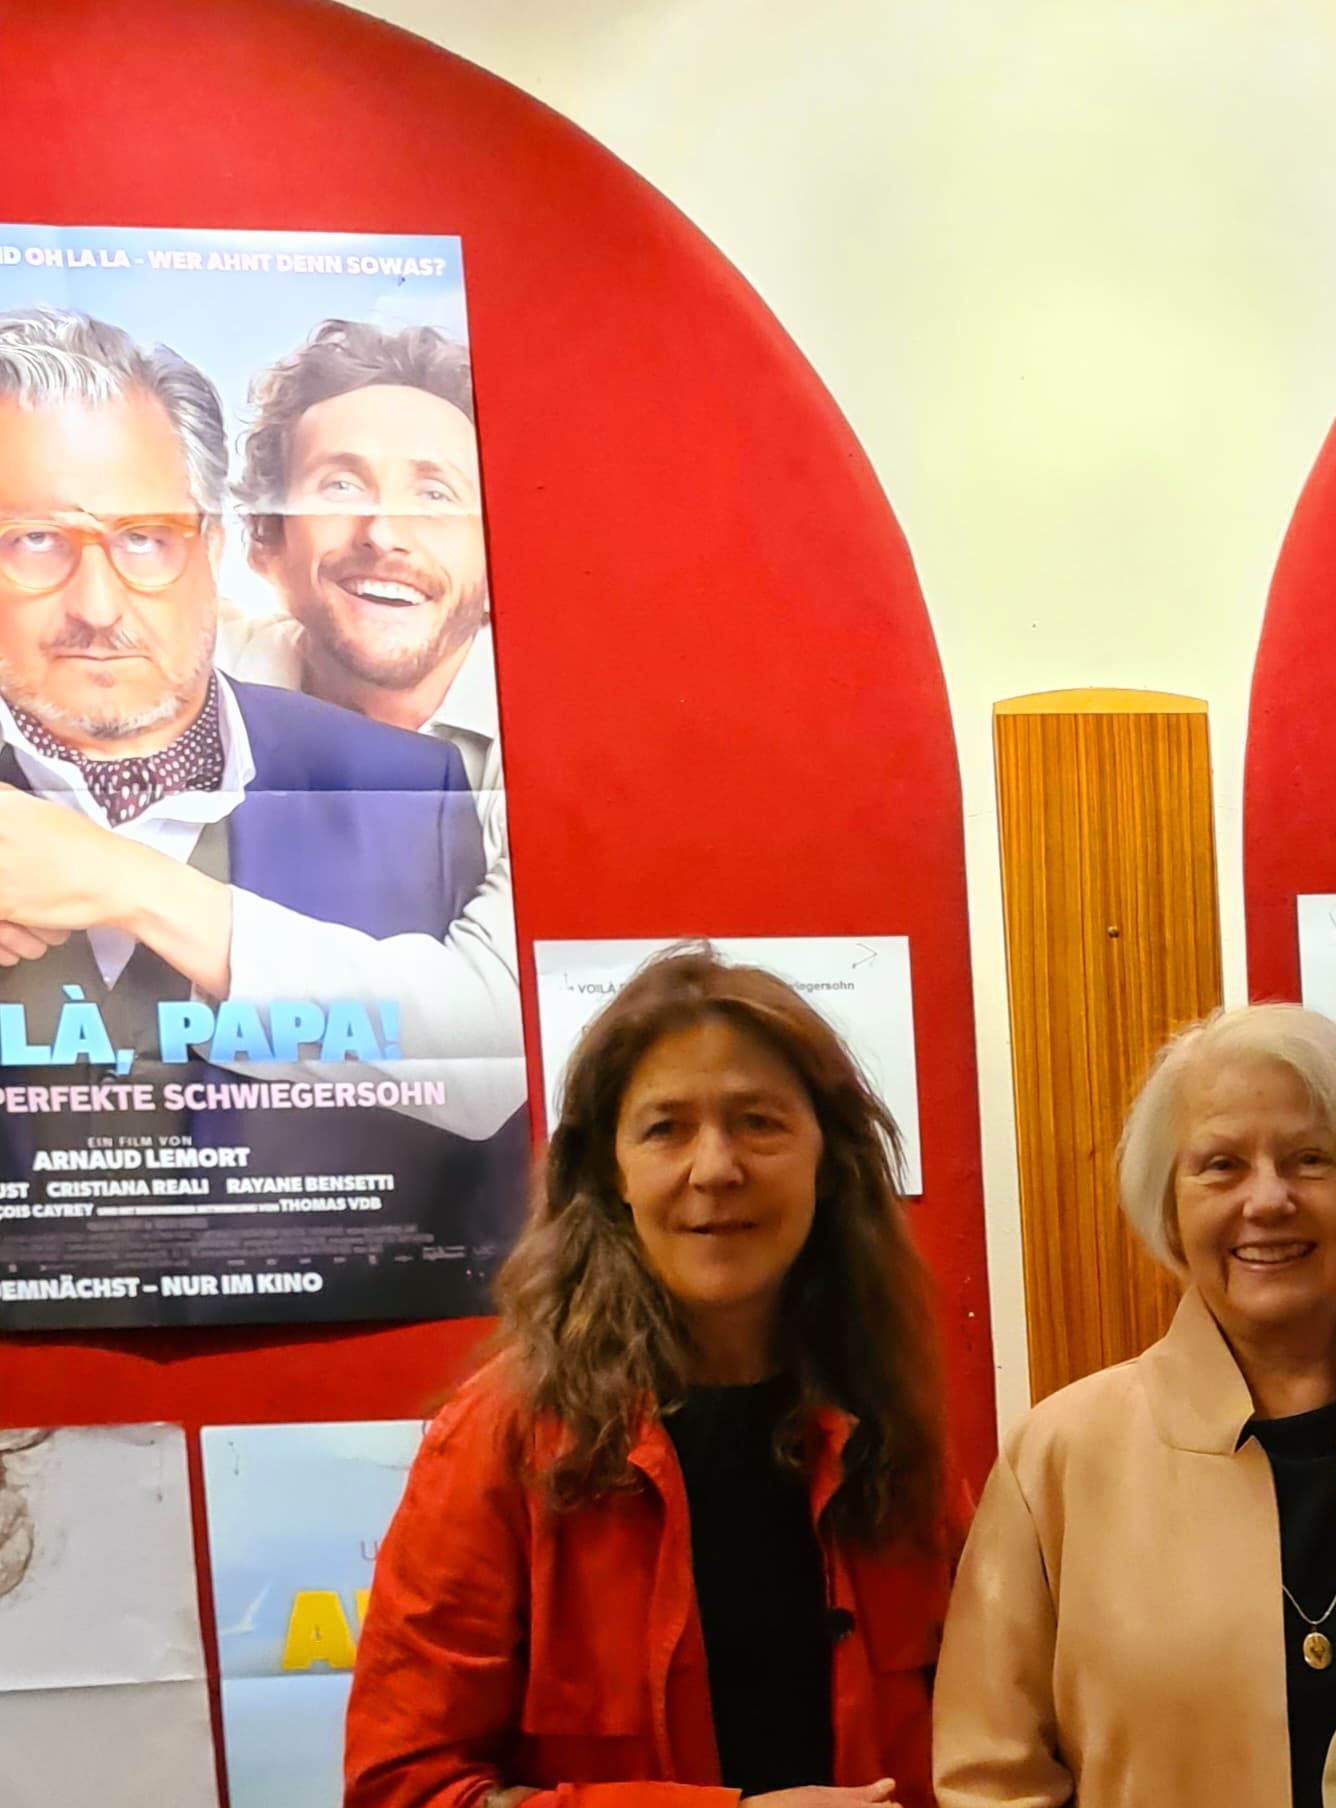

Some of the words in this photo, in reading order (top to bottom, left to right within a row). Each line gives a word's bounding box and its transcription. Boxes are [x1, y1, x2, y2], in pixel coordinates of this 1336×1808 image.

[0, 246, 21, 265] D
[24, 247, 63, 267] OH
[66, 248, 97, 268] LA
[98, 249, 131, 268] LA
[148, 250, 203, 270] WER
[207, 252, 271, 273] AHNT
[276, 254, 342, 274] DENN
[346, 256, 446, 277] SOWAS?
[157, 1000, 402, 1064] PAPA!
[163, 1080, 446, 1111] SCHWIEGERSOHN
[87, 1136, 113, 1148] EIN
[119, 1136, 152, 1147] FILM
[159, 1135, 192, 1147] VON
[33, 1149, 142, 1171] ARNAUD
[145, 1147, 251, 1168] LEMORT
[46, 1179, 150, 1197] CRISTIANA
[151, 1178, 209, 1195] REALI
[226, 1176, 303, 1194] RAYANE
[305, 1174, 395, 1191] BENSETTI
[279, 1198, 346, 1212] THOMAS
[347, 1196, 383, 1211] VDB
[0, 1274, 140, 1301] EMNÄCHST
[160, 1275, 218, 1297] NUR
[221, 1274, 254, 1295] IM
[256, 1272, 323, 1294] KINO
[282, 1587, 372, 1671] A
